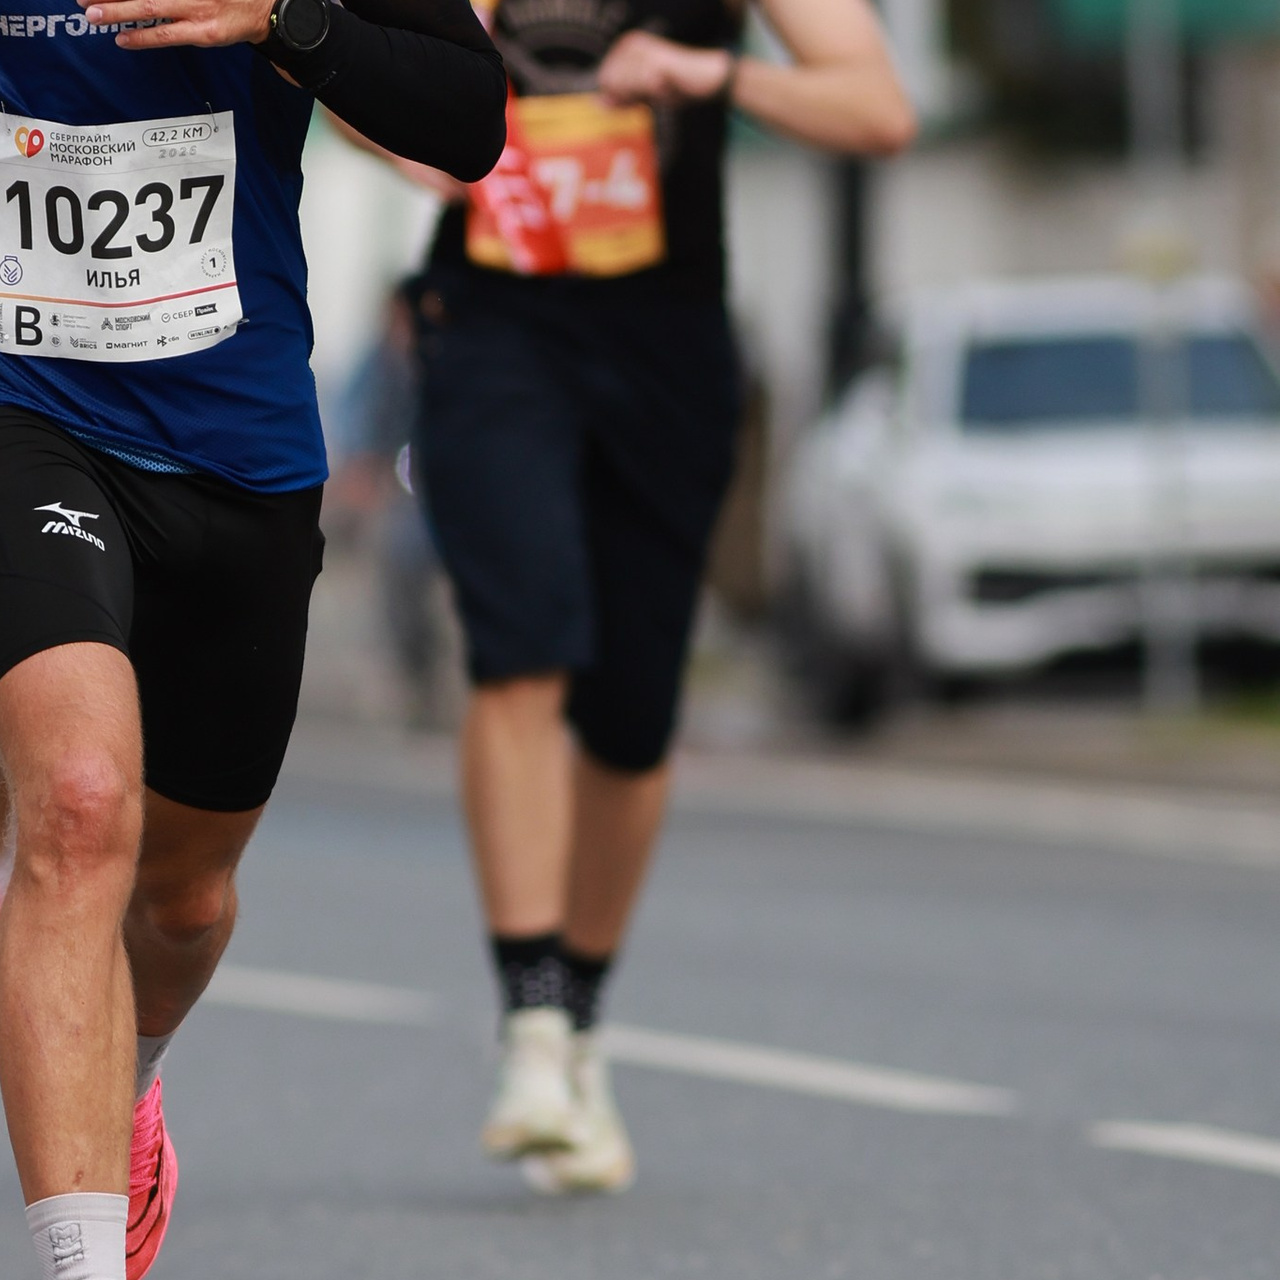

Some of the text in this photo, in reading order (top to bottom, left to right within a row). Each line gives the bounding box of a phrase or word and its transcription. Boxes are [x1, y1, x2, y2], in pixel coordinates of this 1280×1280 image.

[50, 132, 111, 143] СБЕРПРАЙМ
[150, 126, 203, 143] 42,2 КМ
[49, 140, 136, 155] МОСКОВСКИЙ
[51, 153, 112, 166] МАРАФОН
[5, 174, 225, 260] 10237
[209, 256, 216, 268] 1
[86, 268, 141, 289] ИЛЬЯ
[172, 309, 194, 320] СБЕР
[15, 305, 43, 346] B
